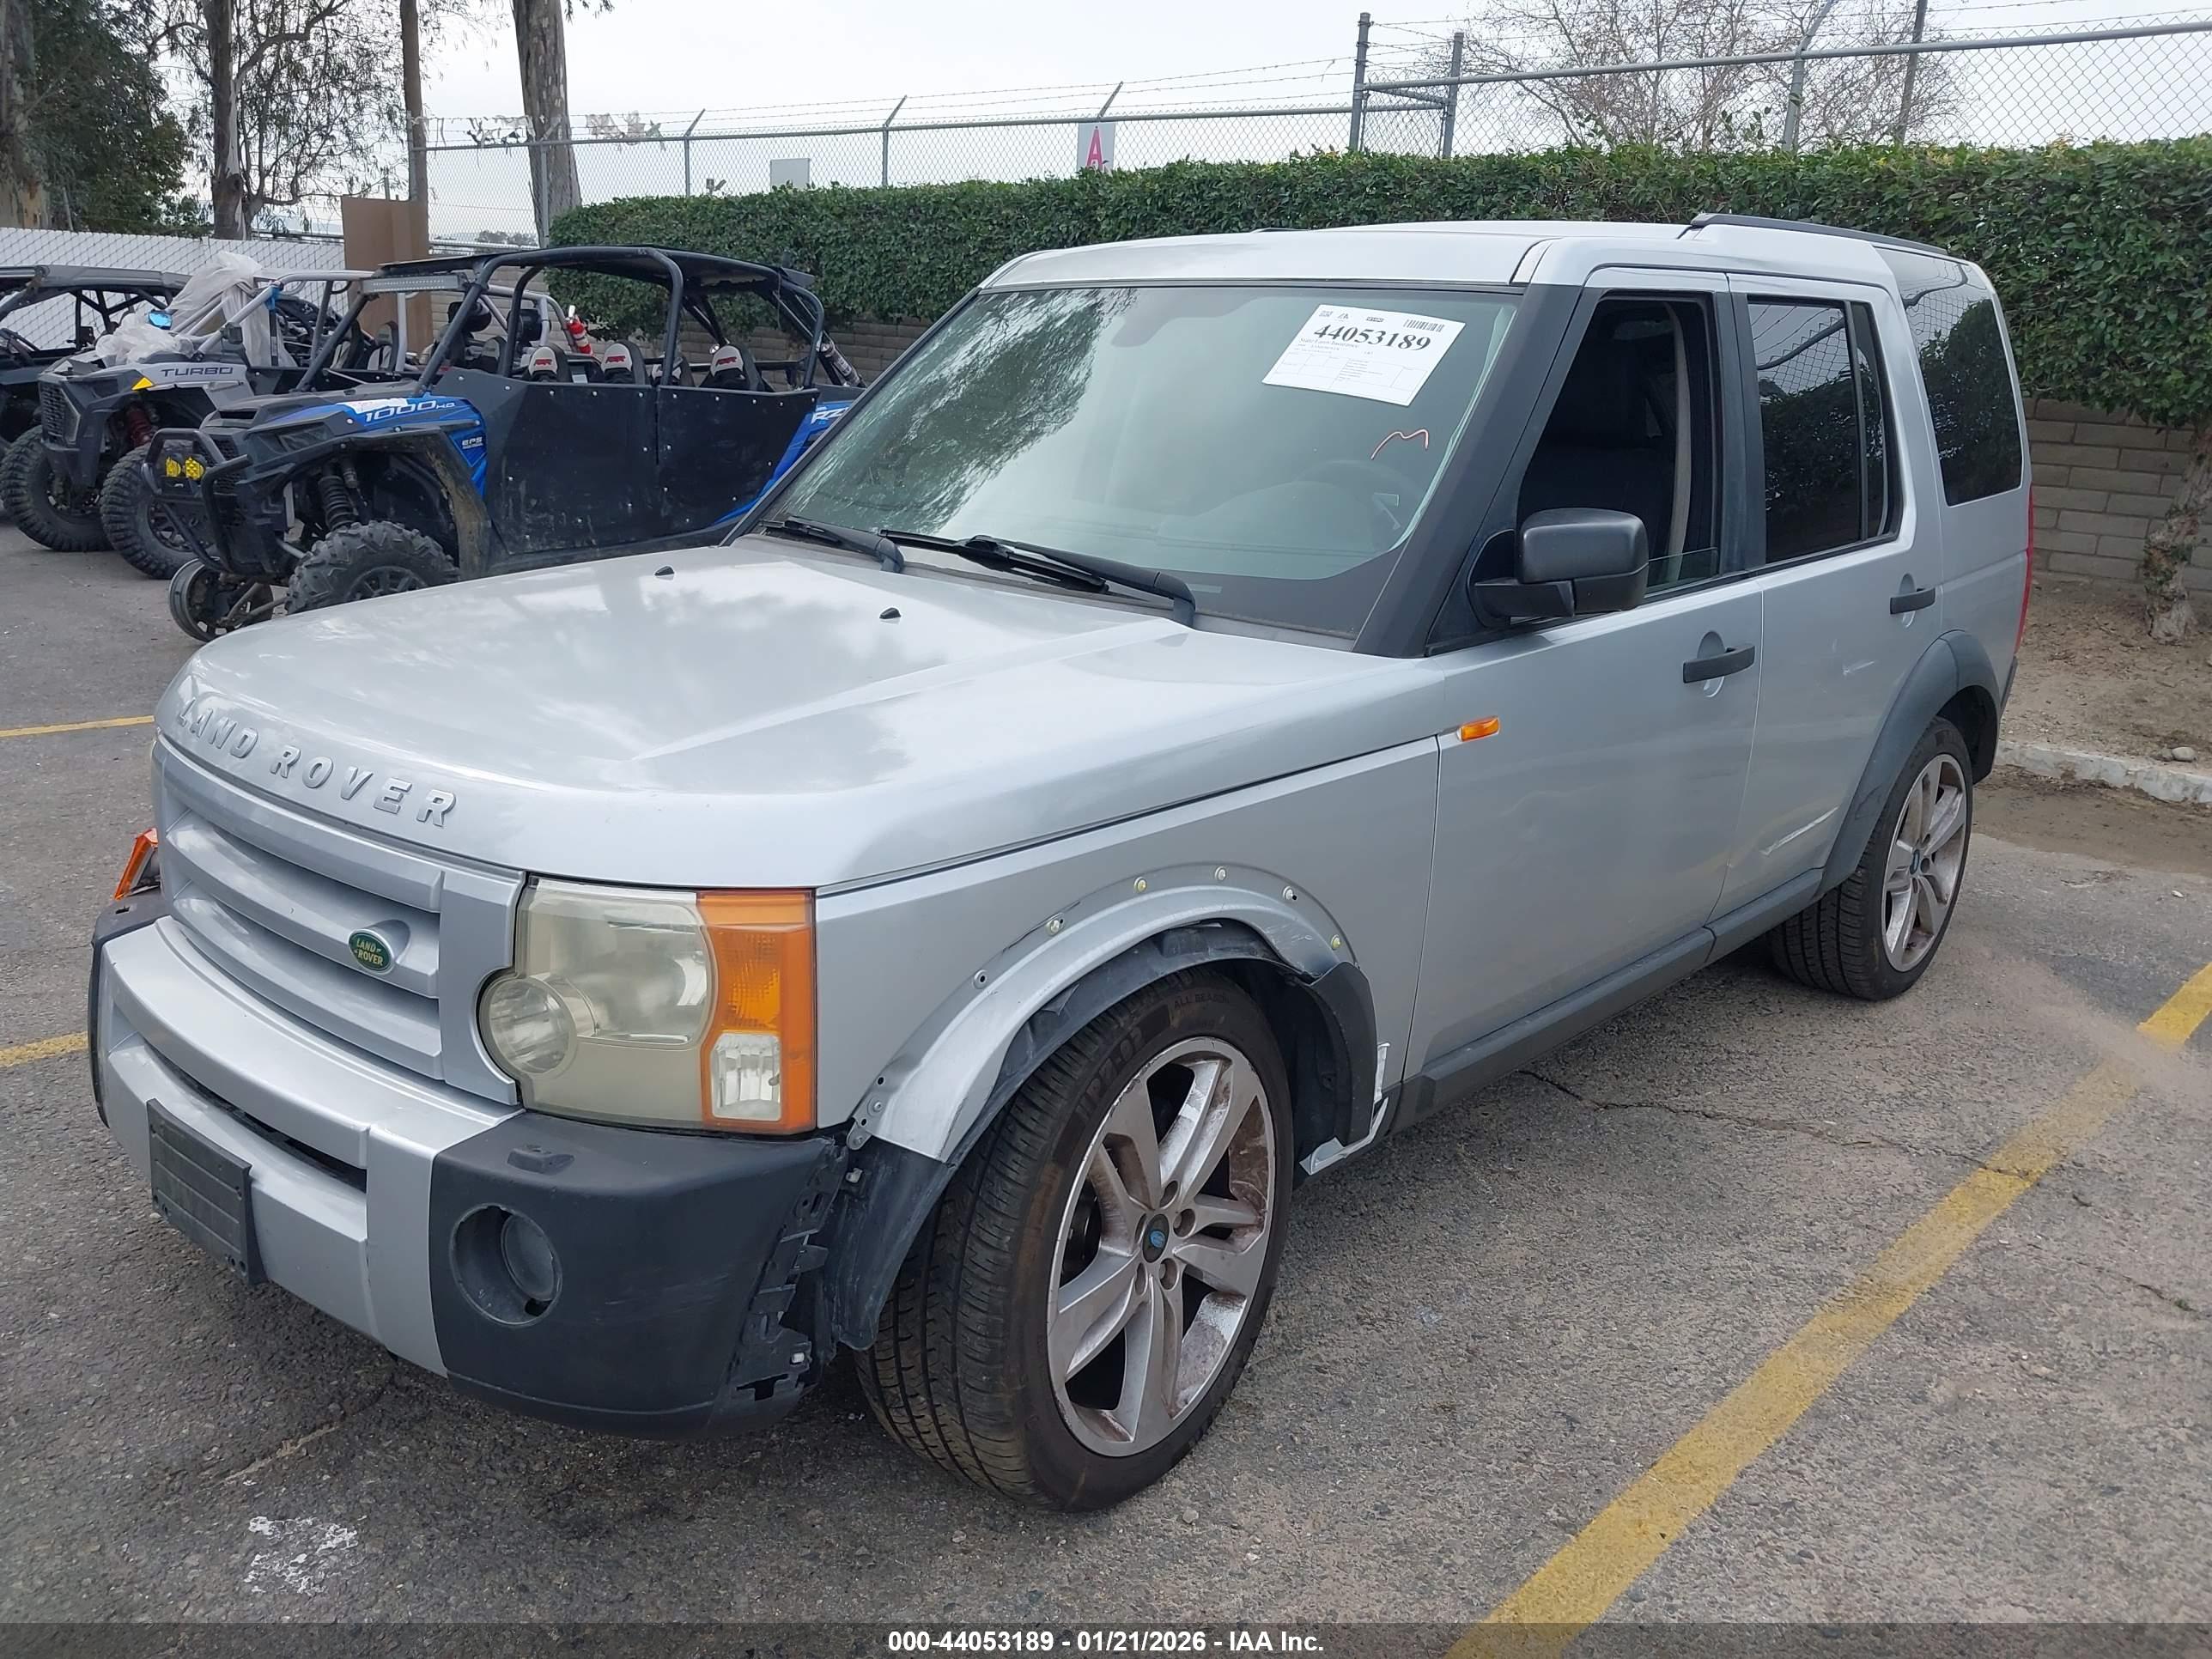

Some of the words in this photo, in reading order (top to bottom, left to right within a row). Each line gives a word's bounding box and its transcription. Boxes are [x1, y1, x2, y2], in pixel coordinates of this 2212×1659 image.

[1314, 324, 1431, 350] 44053189
[161, 367, 234, 377] TURBO
[365, 400, 436, 422] 1000
[462, 436, 483, 446] EPS
[177, 697, 258, 759] LAND
[270, 744, 457, 828] ROVER
[356, 938, 376, 952] LAND
[357, 949, 384, 966] ROVER
